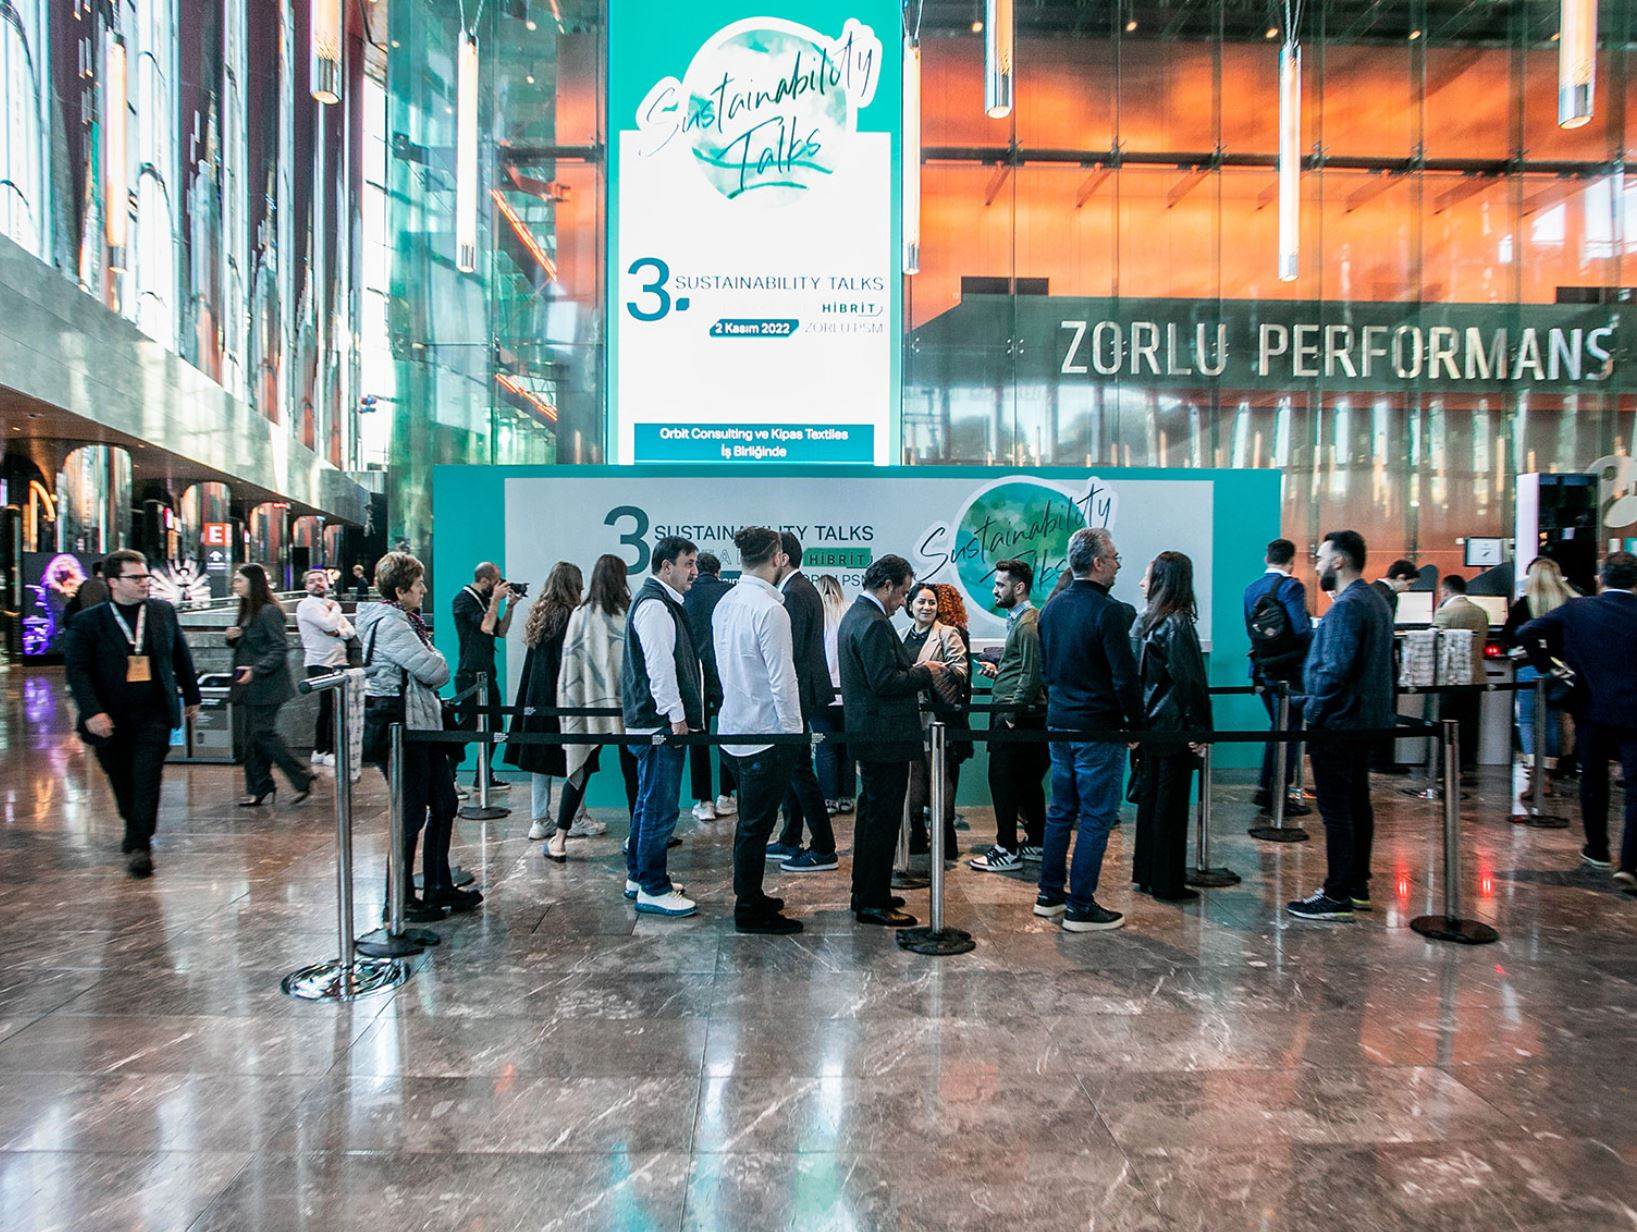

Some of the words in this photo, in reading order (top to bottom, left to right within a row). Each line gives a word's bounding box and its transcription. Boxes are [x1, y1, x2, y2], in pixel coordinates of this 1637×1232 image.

[639, 31, 873, 157] Sustainability
[717, 116, 821, 191] Talks
[675, 275, 820, 290] SUSTAINABILITY
[829, 276, 884, 291] TALKS
[715, 322, 723, 334] 2
[761, 322, 790, 334] 2022
[1060, 320, 1227, 376] ZORLU
[1258, 323, 1614, 381] PERFORMANS
[660, 428, 689, 439] Orbit
[691, 427, 753, 441] Consulting
[755, 430, 769, 439] ve
[805, 428, 849, 440] Textiles
[734, 445, 787, 459] Birliğinde
[208, 525, 224, 543] E
[815, 525, 874, 541] TALKS
[916, 483, 1112, 581] Sustainability
